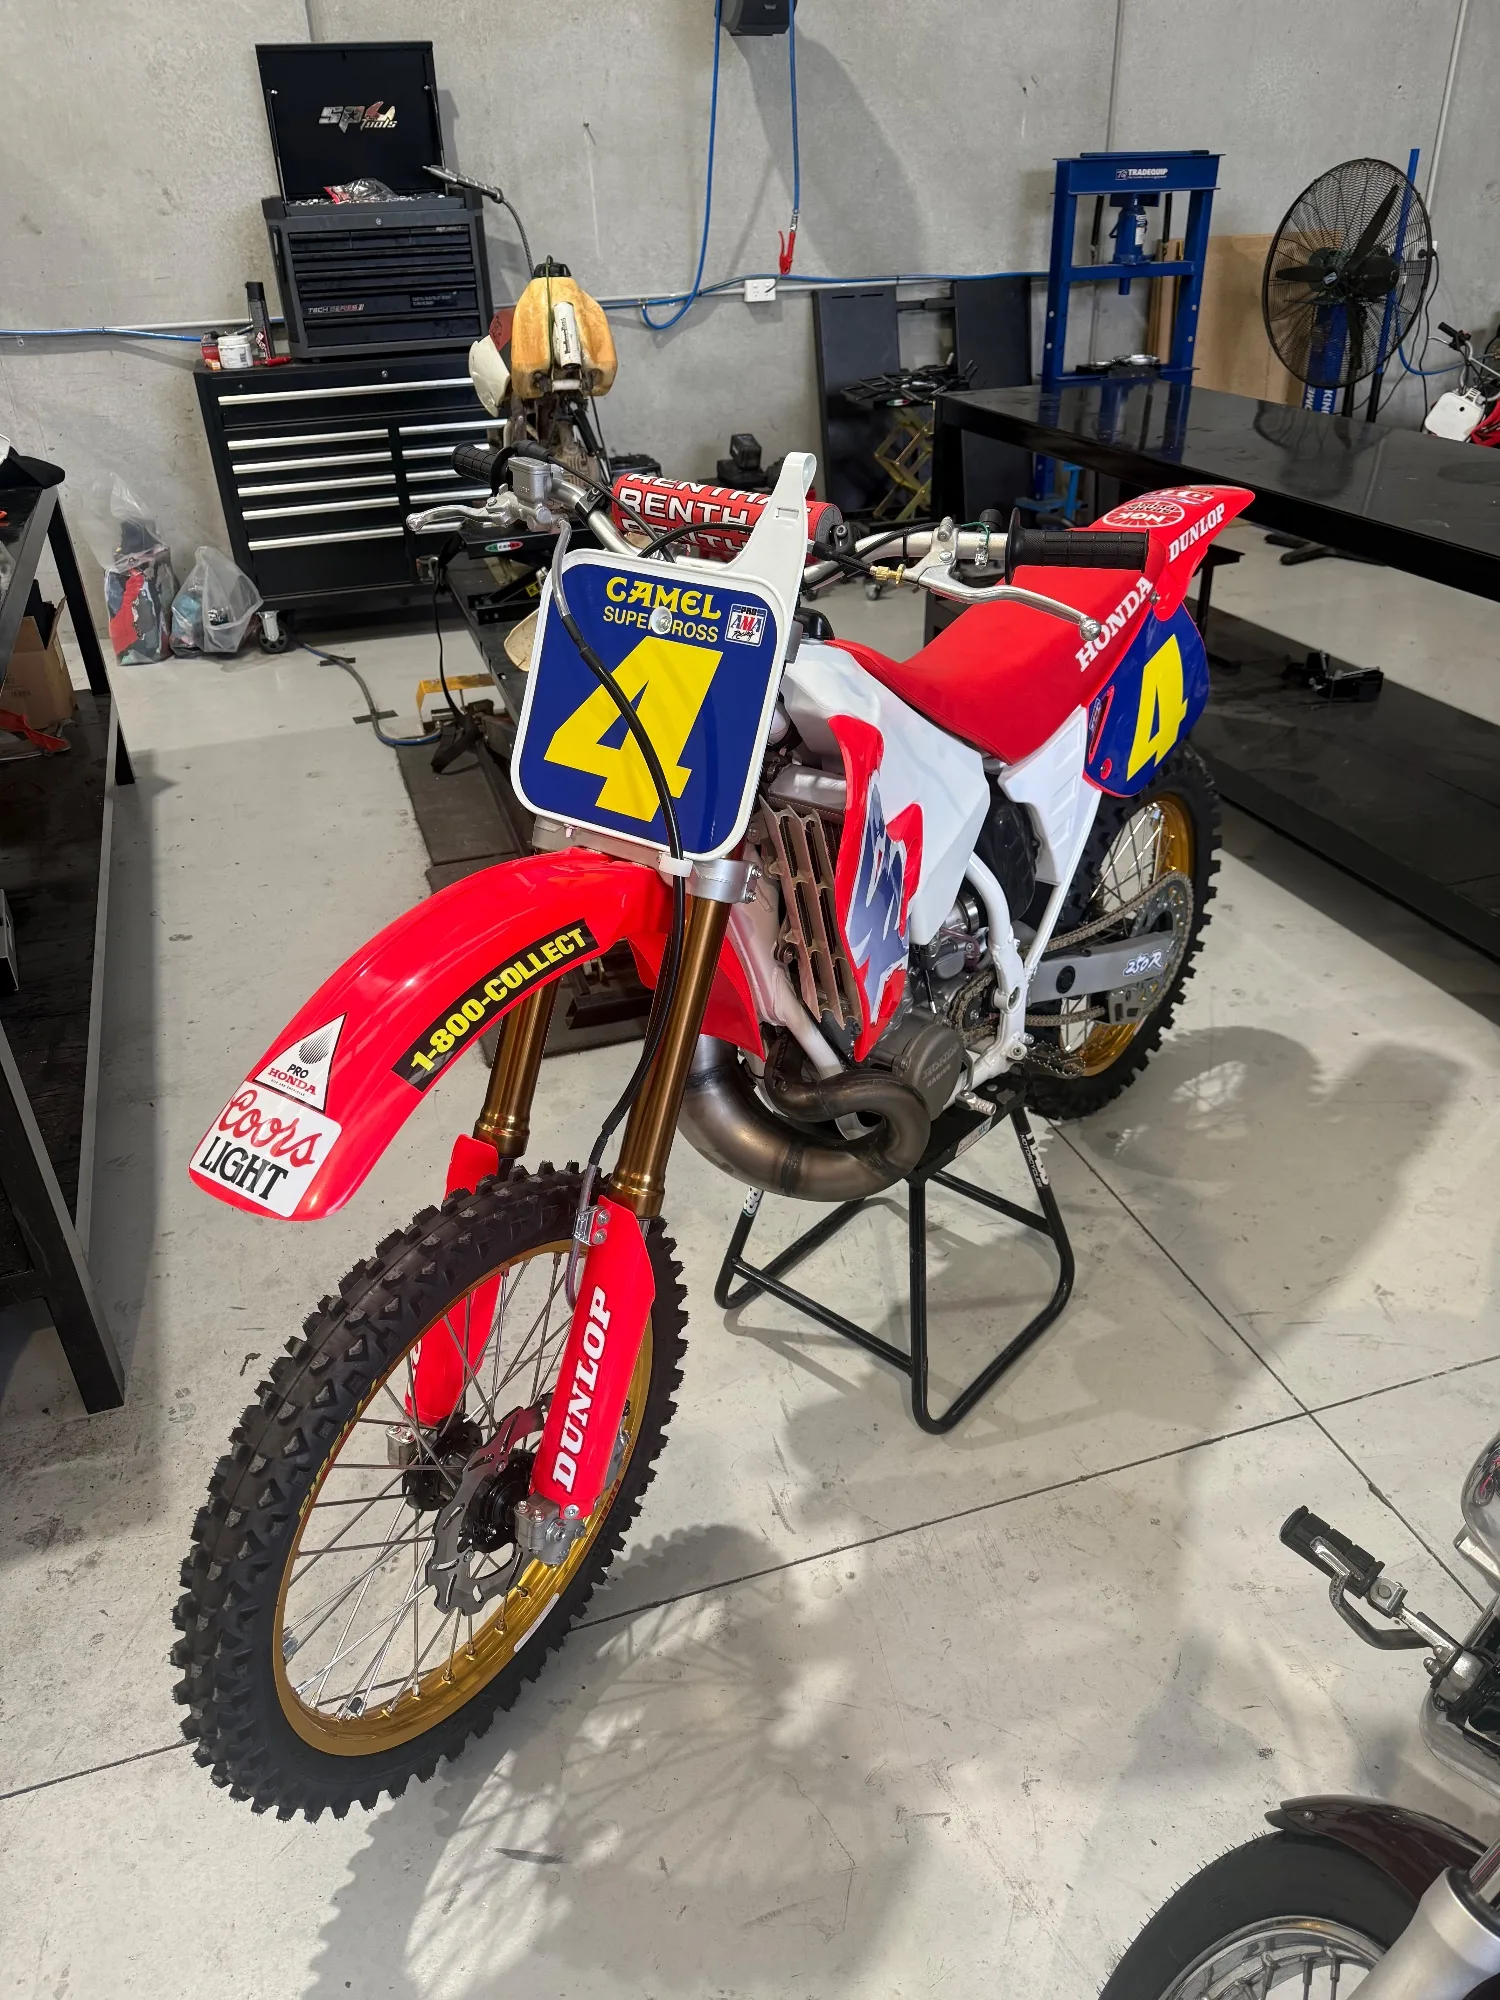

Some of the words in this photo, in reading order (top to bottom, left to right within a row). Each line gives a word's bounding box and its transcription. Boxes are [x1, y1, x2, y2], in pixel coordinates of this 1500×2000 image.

[1128, 168, 1168, 176] TRADEQUIP
[1119, 511, 1166, 523] NGK
[1169, 503, 1225, 563] DUNLOP
[606, 576, 721, 620] CAMEL
[740, 606, 758, 616] PRO
[603, 606, 719, 643] SUPEROSS
[730, 614, 763, 633] AMA
[1075, 576, 1153, 672] HONDA
[544, 636, 723, 822] 4
[1127, 634, 1188, 781] 4
[1123, 949, 1163, 976] 250R
[410, 928, 587, 1071] 1-800-COLLECT
[268, 1067, 317, 1096] HONDA
[287, 1063, 309, 1079] PRO
[218, 1090, 322, 1167] Coors
[199, 1136, 289, 1200] LIGHT
[1020, 1134, 1043, 1188] MOTORCYCLES
[552, 1286, 611, 1493] DUNLOP
